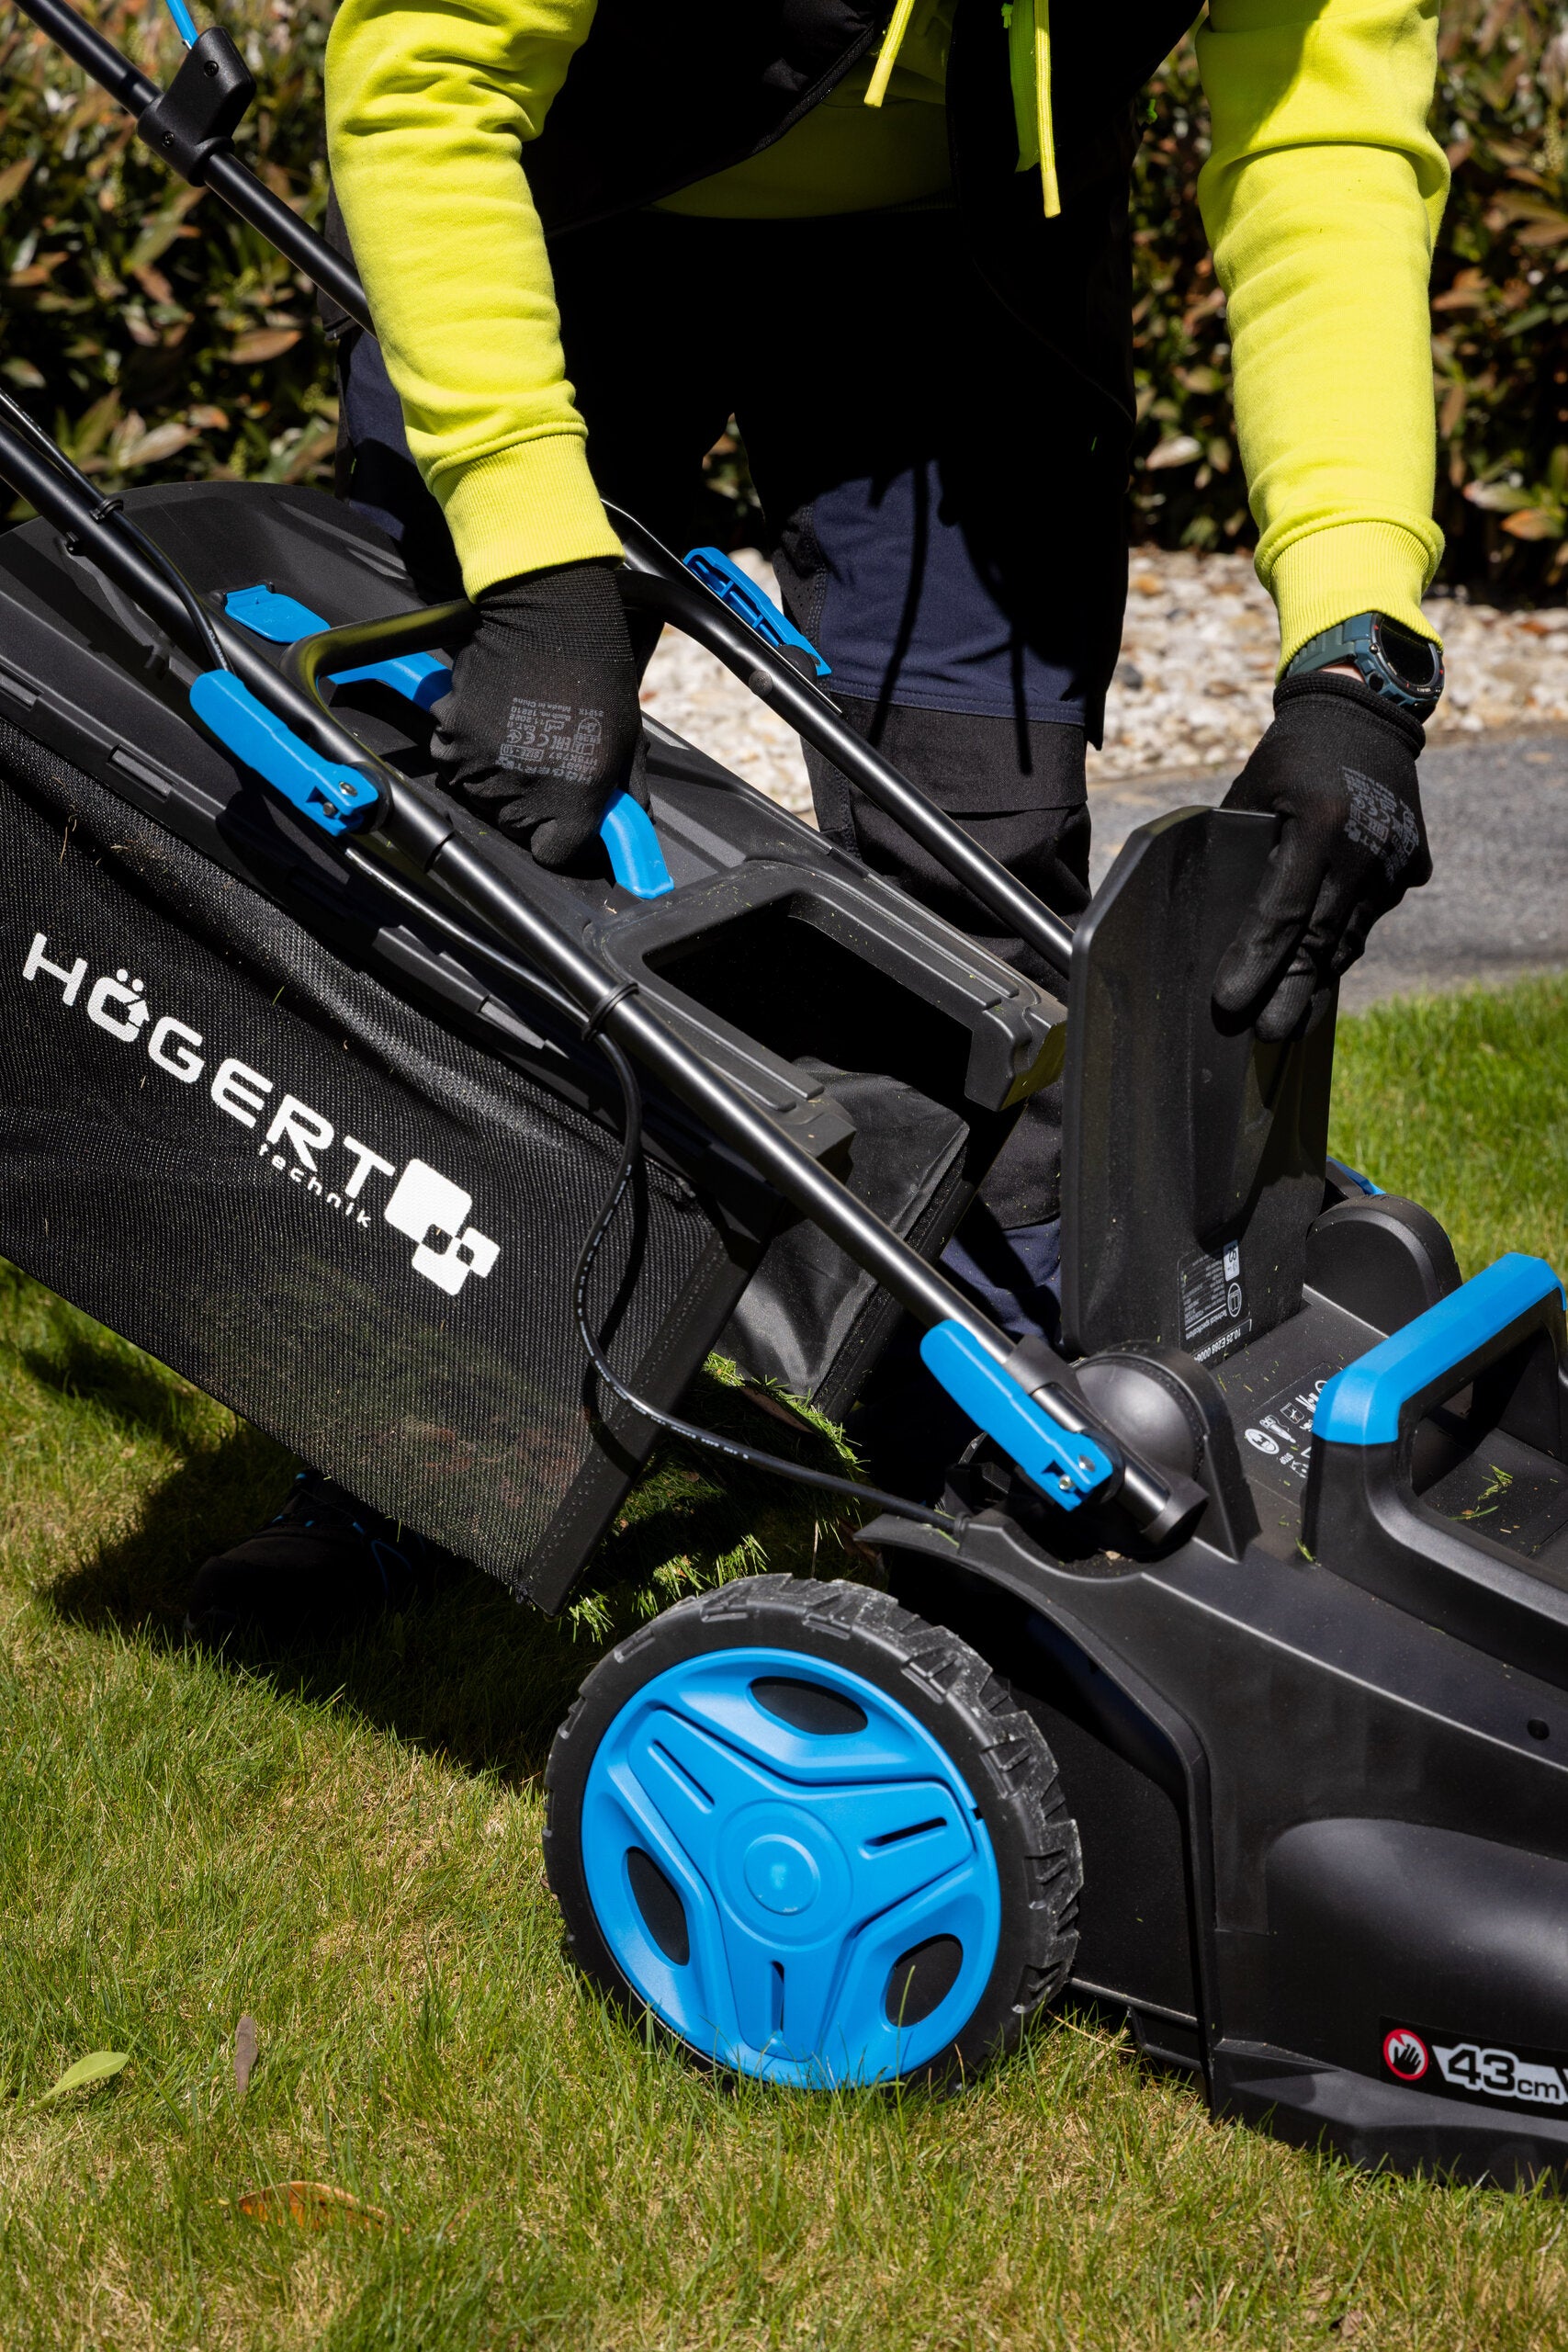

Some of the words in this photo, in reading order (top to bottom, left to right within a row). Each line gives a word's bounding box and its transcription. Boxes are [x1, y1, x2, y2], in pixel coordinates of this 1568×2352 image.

[22, 933, 395, 1198] HÖGERT
[259, 1144, 371, 1227] technik
[1448, 2048, 1560, 2099] 43cm
